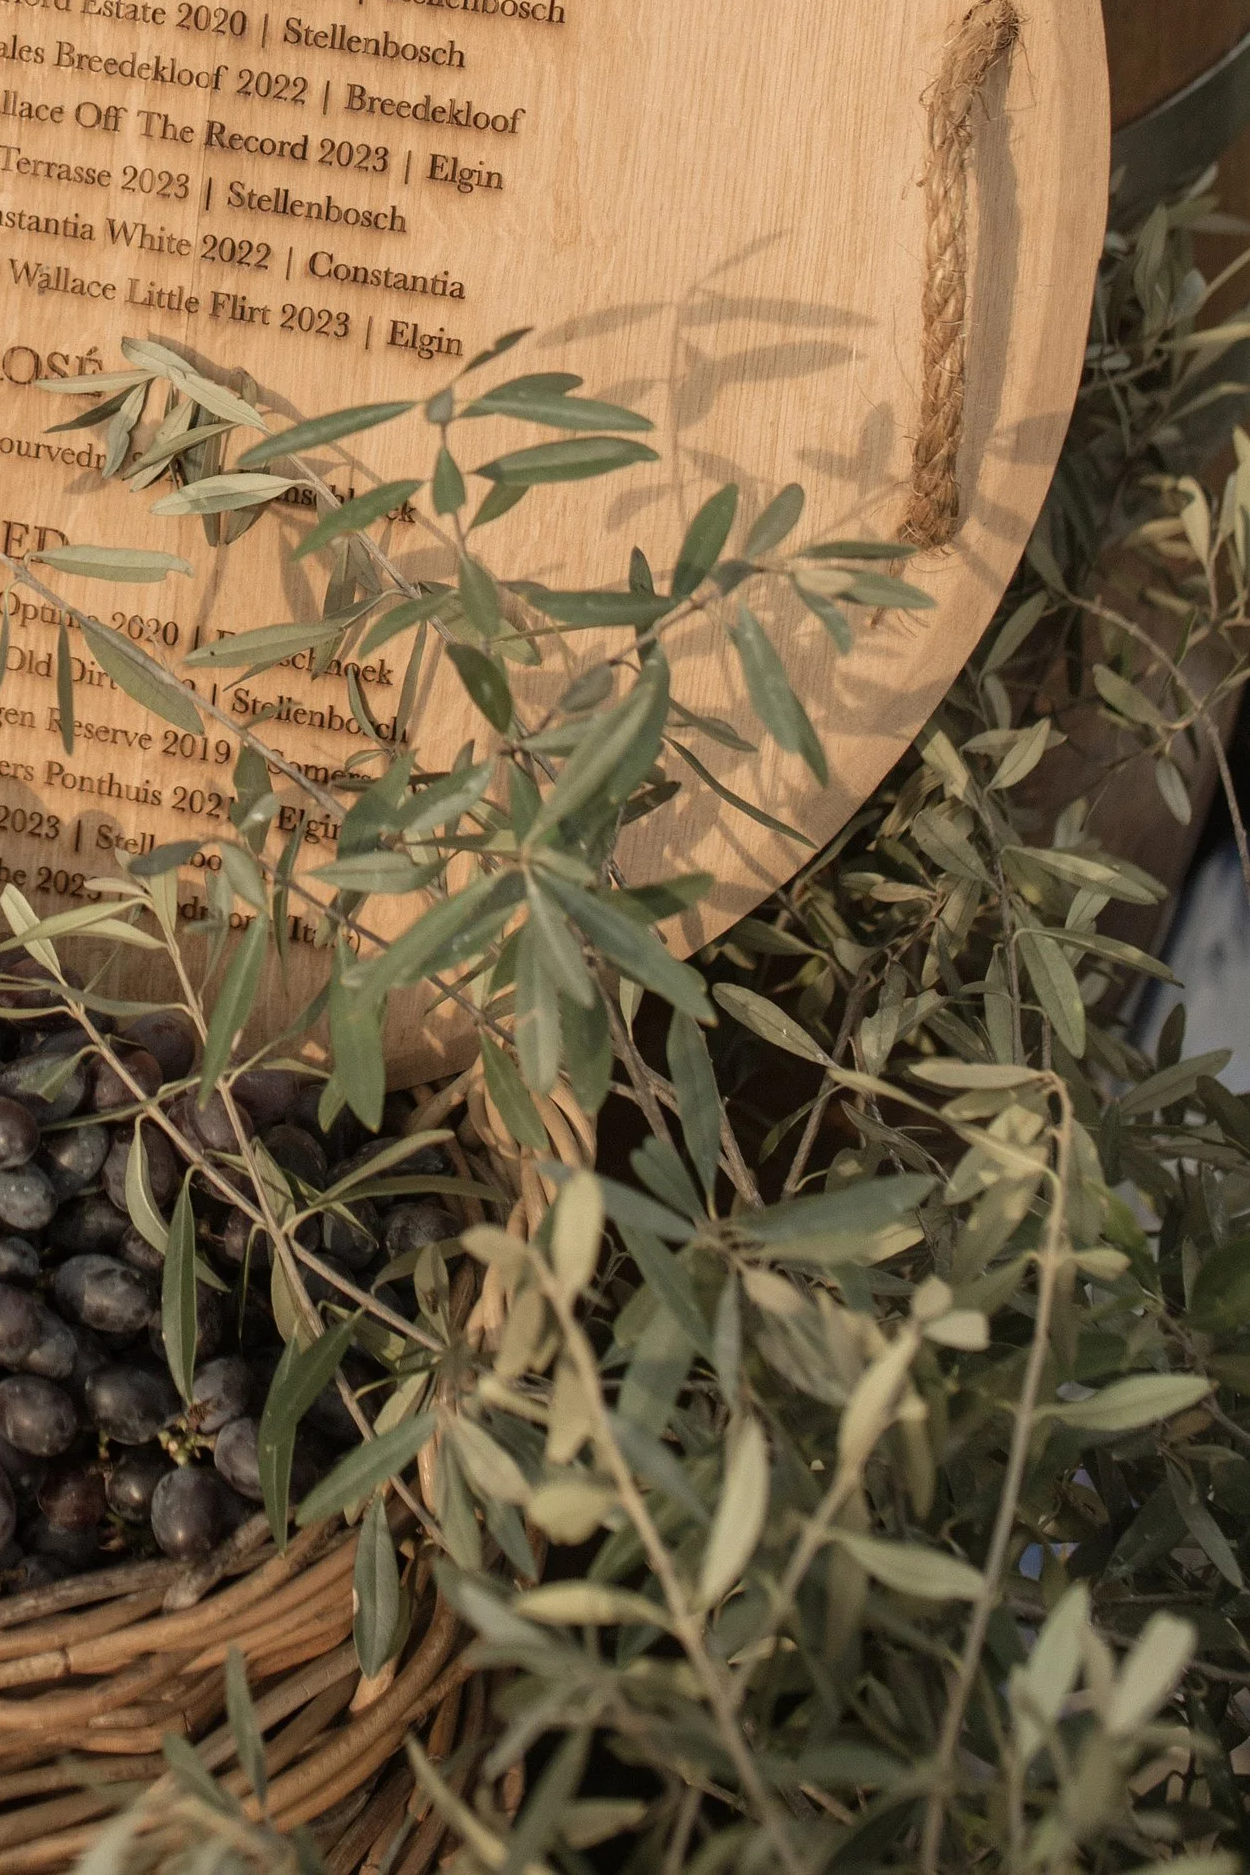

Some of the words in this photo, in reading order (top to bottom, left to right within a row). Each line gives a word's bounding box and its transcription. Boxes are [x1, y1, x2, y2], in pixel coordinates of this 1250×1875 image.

[177, 3, 247, 37] 2020
[283, 17, 465, 68] Stellenbosch
[54, 40, 228, 92] Breedekloof
[237, 69, 308, 106] 2022
[345, 83, 525, 134] Breedekloof
[75, 102, 127, 133] Off
[138, 110, 195, 145] The
[204, 120, 309, 162] Record
[319, 139, 390, 174] 2023
[427, 154, 504, 193] Elgin
[121, 166, 189, 200] 2023
[228, 181, 407, 233] Stellenbosch
[106, 217, 191, 257] White
[201, 234, 272, 270] 2022
[309, 251, 466, 300] Constantia
[8, 259, 116, 301] Wallace
[124, 278, 200, 314] Little
[209, 291, 271, 326] Flirt
[280, 303, 350, 339] 2023
[387, 319, 463, 359] Elgin
[5, 646, 52, 678] Old
[231, 687, 407, 744] Stellenboch
[45, 760, 162, 807] Ponthuis
[163, 730, 230, 765] 2019
